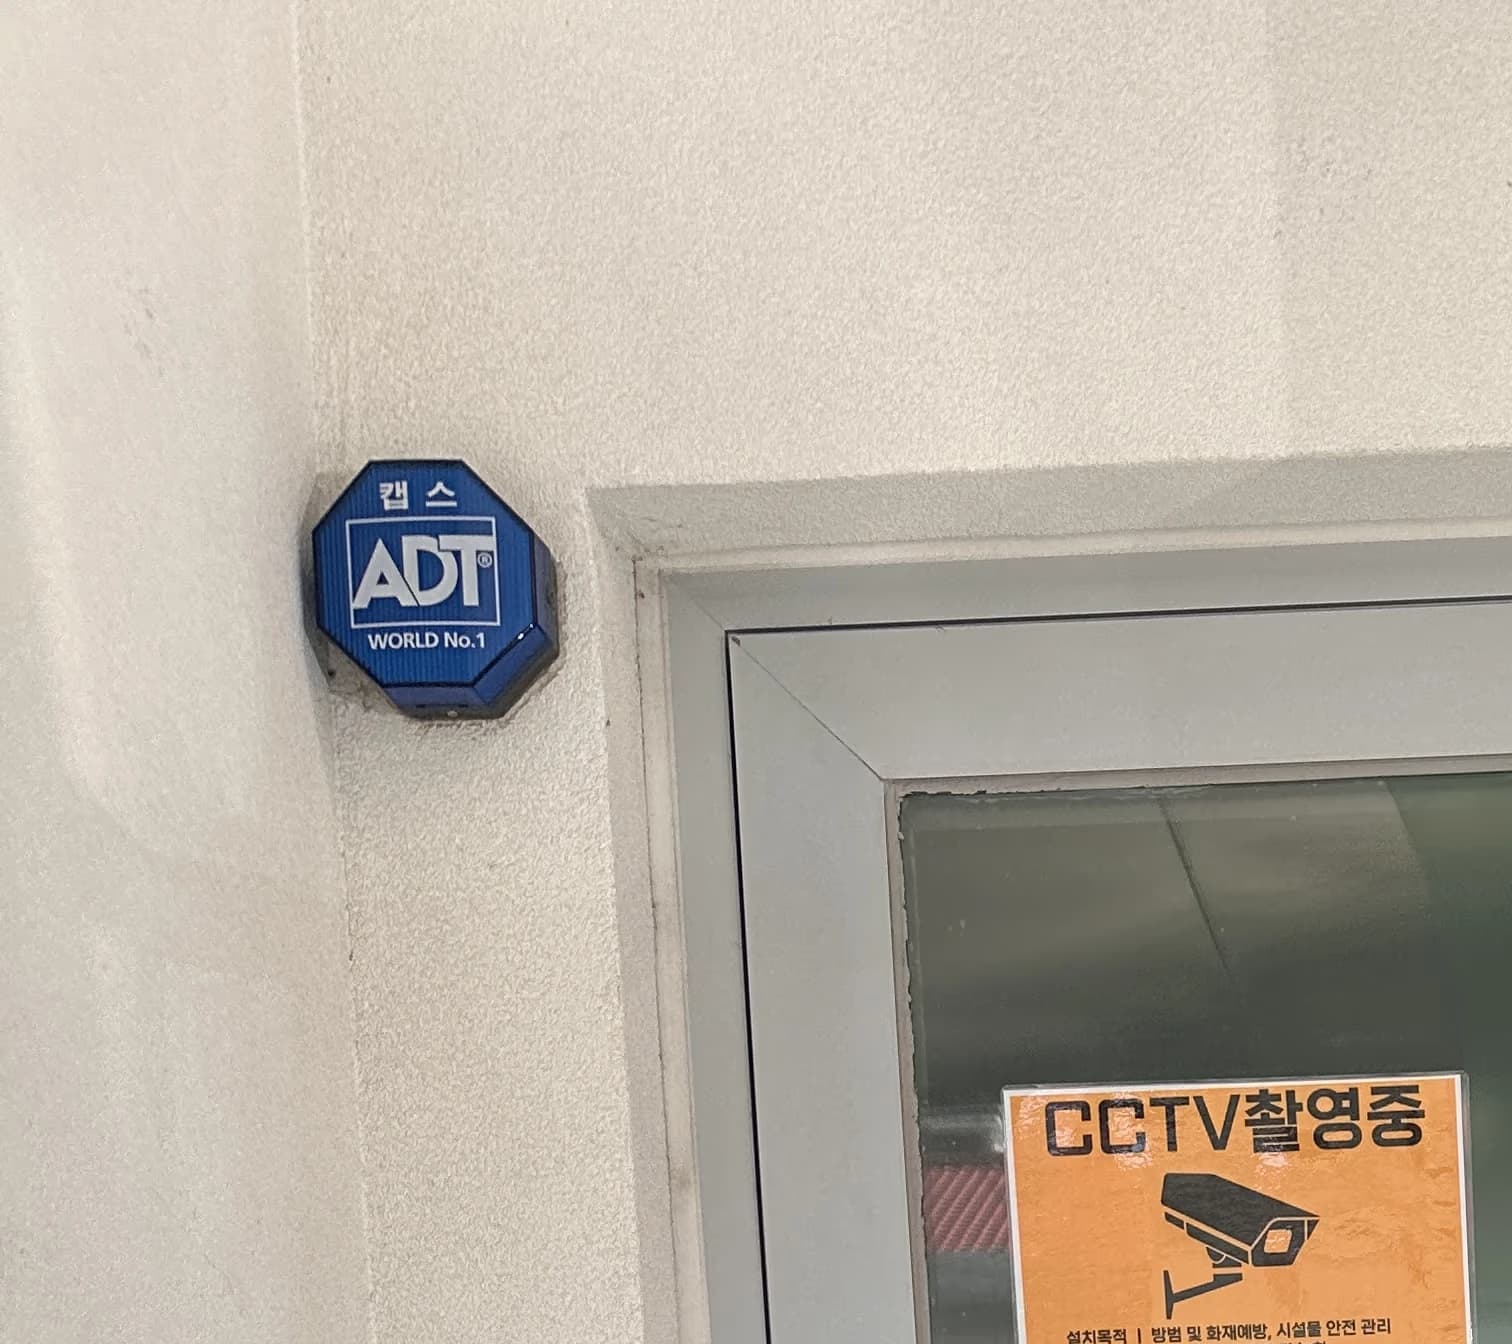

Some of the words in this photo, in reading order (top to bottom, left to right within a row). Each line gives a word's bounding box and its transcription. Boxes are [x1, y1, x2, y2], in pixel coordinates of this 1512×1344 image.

[351, 534, 496, 609] ADT
[368, 632, 439, 649] WORLD
[444, 632, 485, 649] No.1
[1045, 1085, 1426, 1156] CCTV촬영중
[1151, 1327, 1182, 1343] 방범
[1187, 1327, 1201, 1342] 및
[1207, 1323, 1271, 1342] 화재예방,
[1277, 1321, 1321, 1338] 시설물
[1326, 1320, 1356, 1337] 안전
[1361, 1318, 1391, 1335] 관리
